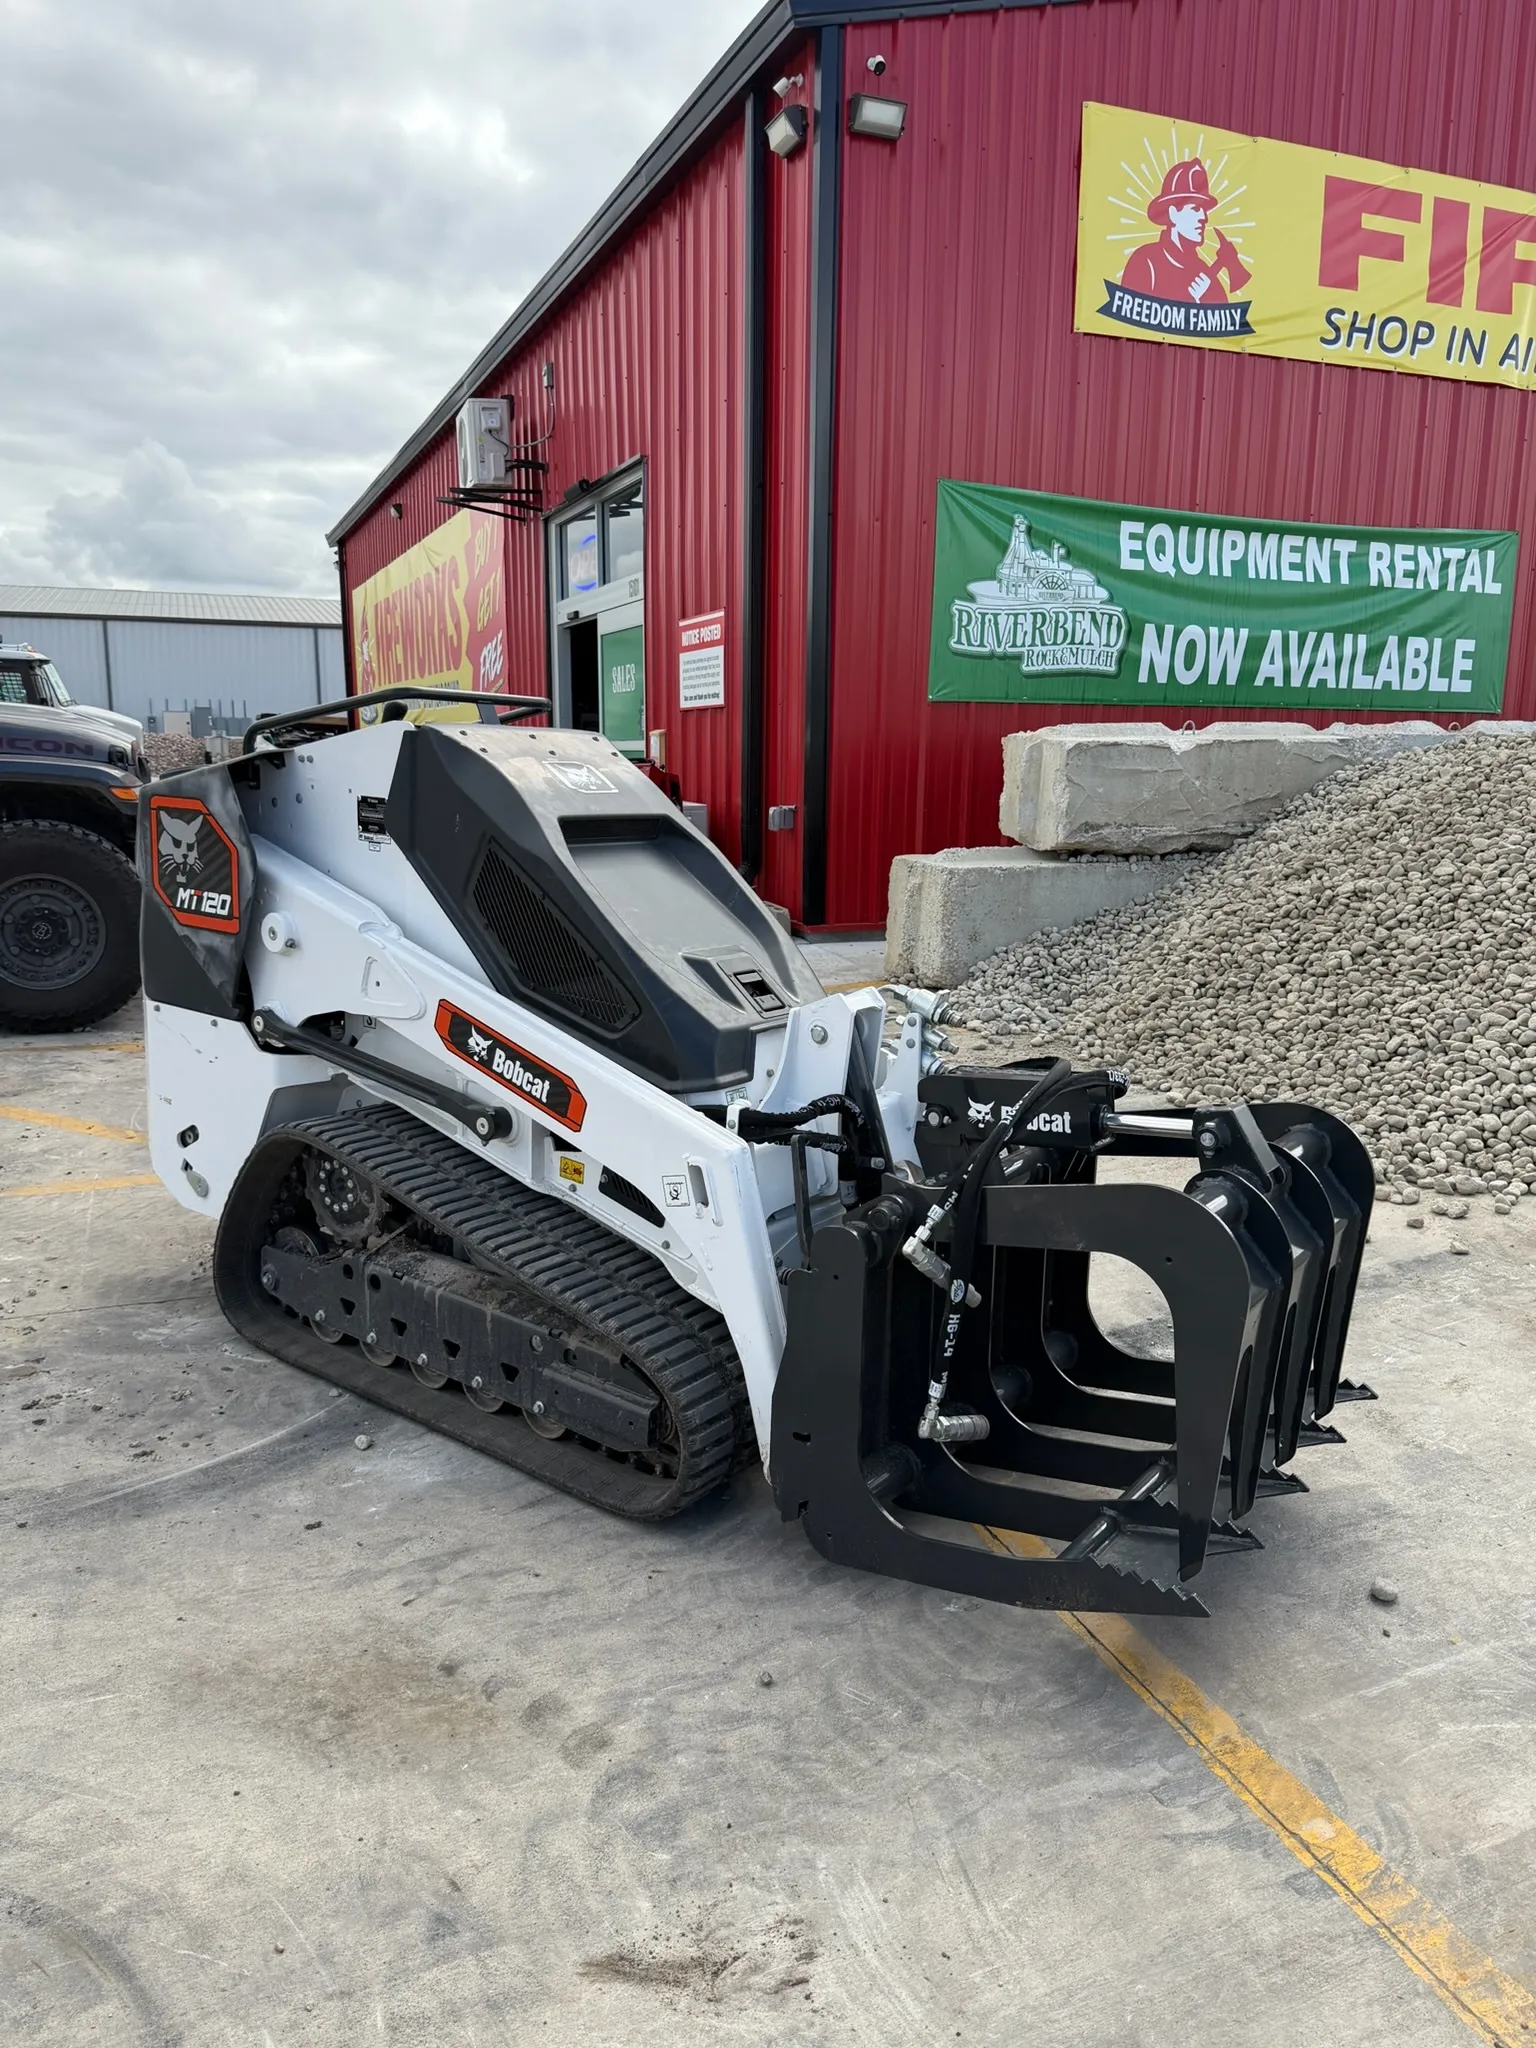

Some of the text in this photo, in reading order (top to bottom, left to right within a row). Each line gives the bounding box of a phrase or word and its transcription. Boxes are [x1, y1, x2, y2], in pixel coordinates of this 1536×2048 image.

[1111, 290, 1242, 332] FREEDOM FAMILY
[1319, 307, 1436, 359] SHOP
[1446, 325, 1488, 368] IN
[1119, 520, 1502, 594] EQUIPMENT RENTAL
[374, 555, 464, 688] FIREWORKS
[477, 572, 496, 632] GET
[953, 606, 1123, 649] RIVERBEND
[480, 629, 503, 691] FREE
[681, 623, 721, 647] NOTICE POSTED
[1137, 623, 1476, 692] NOW AVAILABLE
[612, 663, 636, 693] SALES
[492, 1047, 550, 1103] Bobcat
